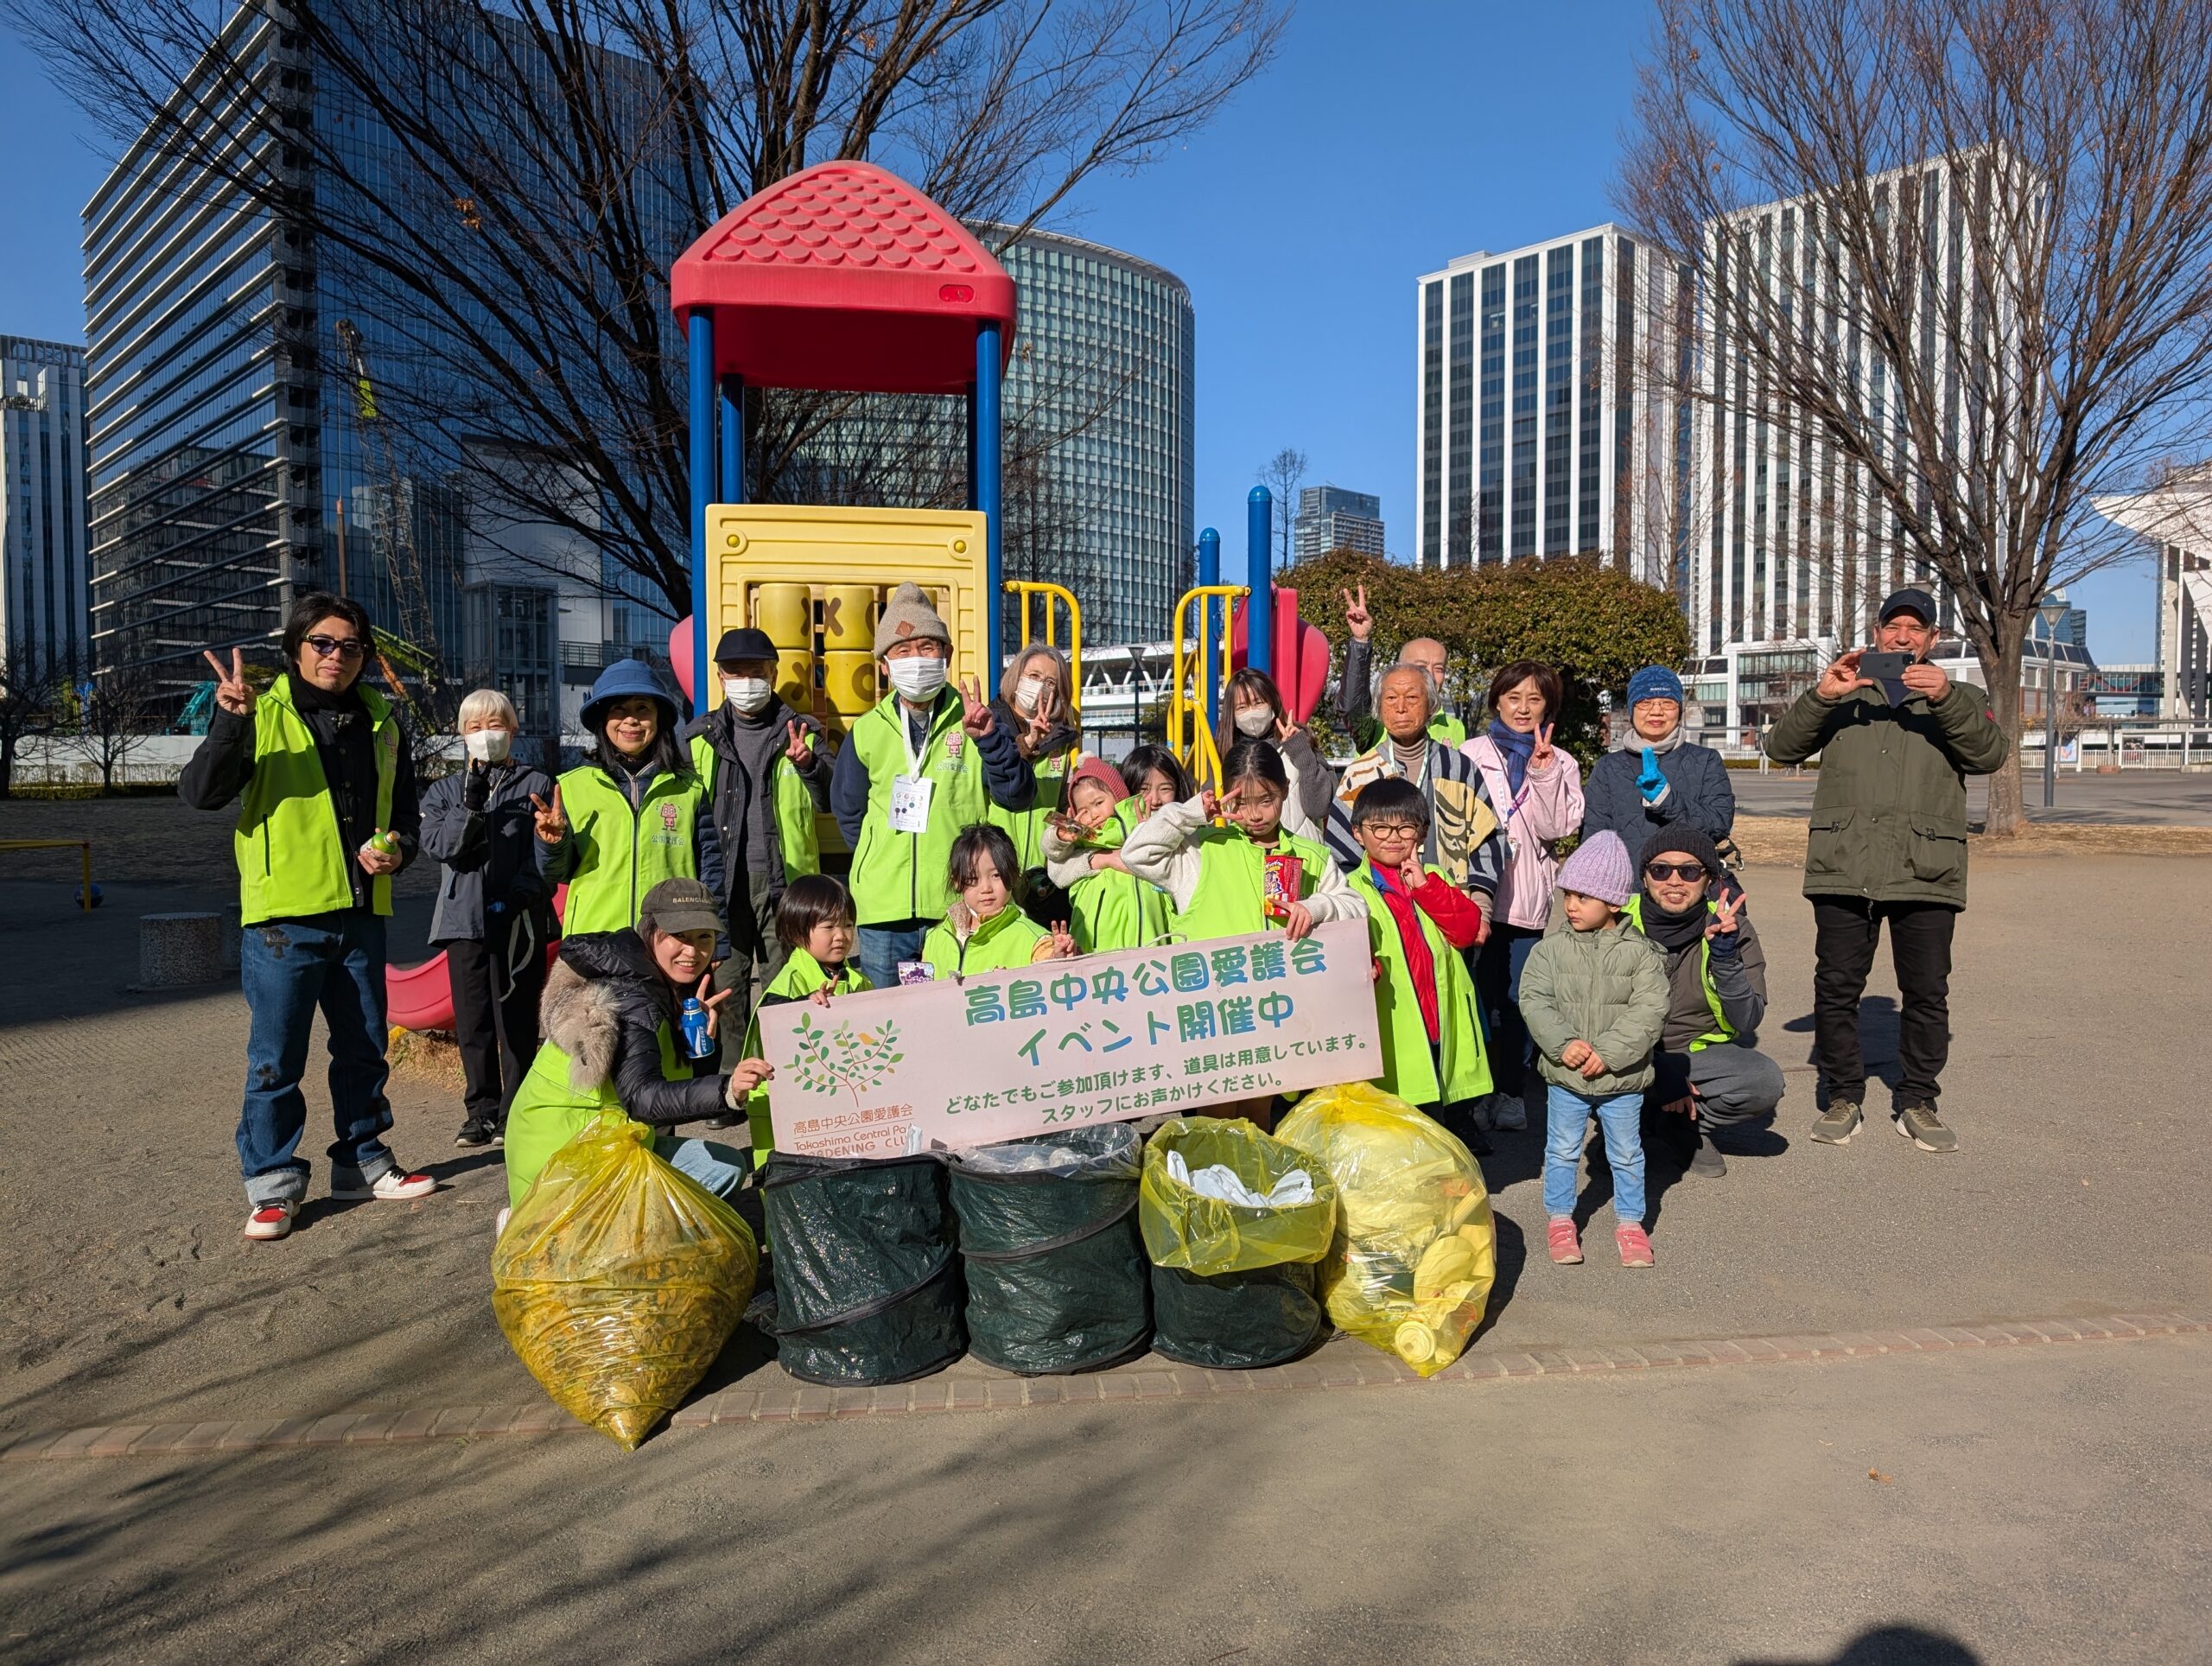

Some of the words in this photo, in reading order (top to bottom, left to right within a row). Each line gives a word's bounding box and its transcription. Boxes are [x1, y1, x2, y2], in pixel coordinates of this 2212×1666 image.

[964, 937, 1327, 1027] 高島中央公園愛護会
[1017, 990, 1294, 1066] イベント開催中
[946, 1033, 1368, 1115] どなたでもご参加頂けます、道具は用意しています。
[1042, 1072, 1282, 1124] スタッフにお声かけください。
[793, 1103, 913, 1135] 高島中央公園愛護会
[794, 1136, 851, 1152] Takashima
[854, 1127, 890, 1141] Central
[893, 1125, 906, 1135] Pa
